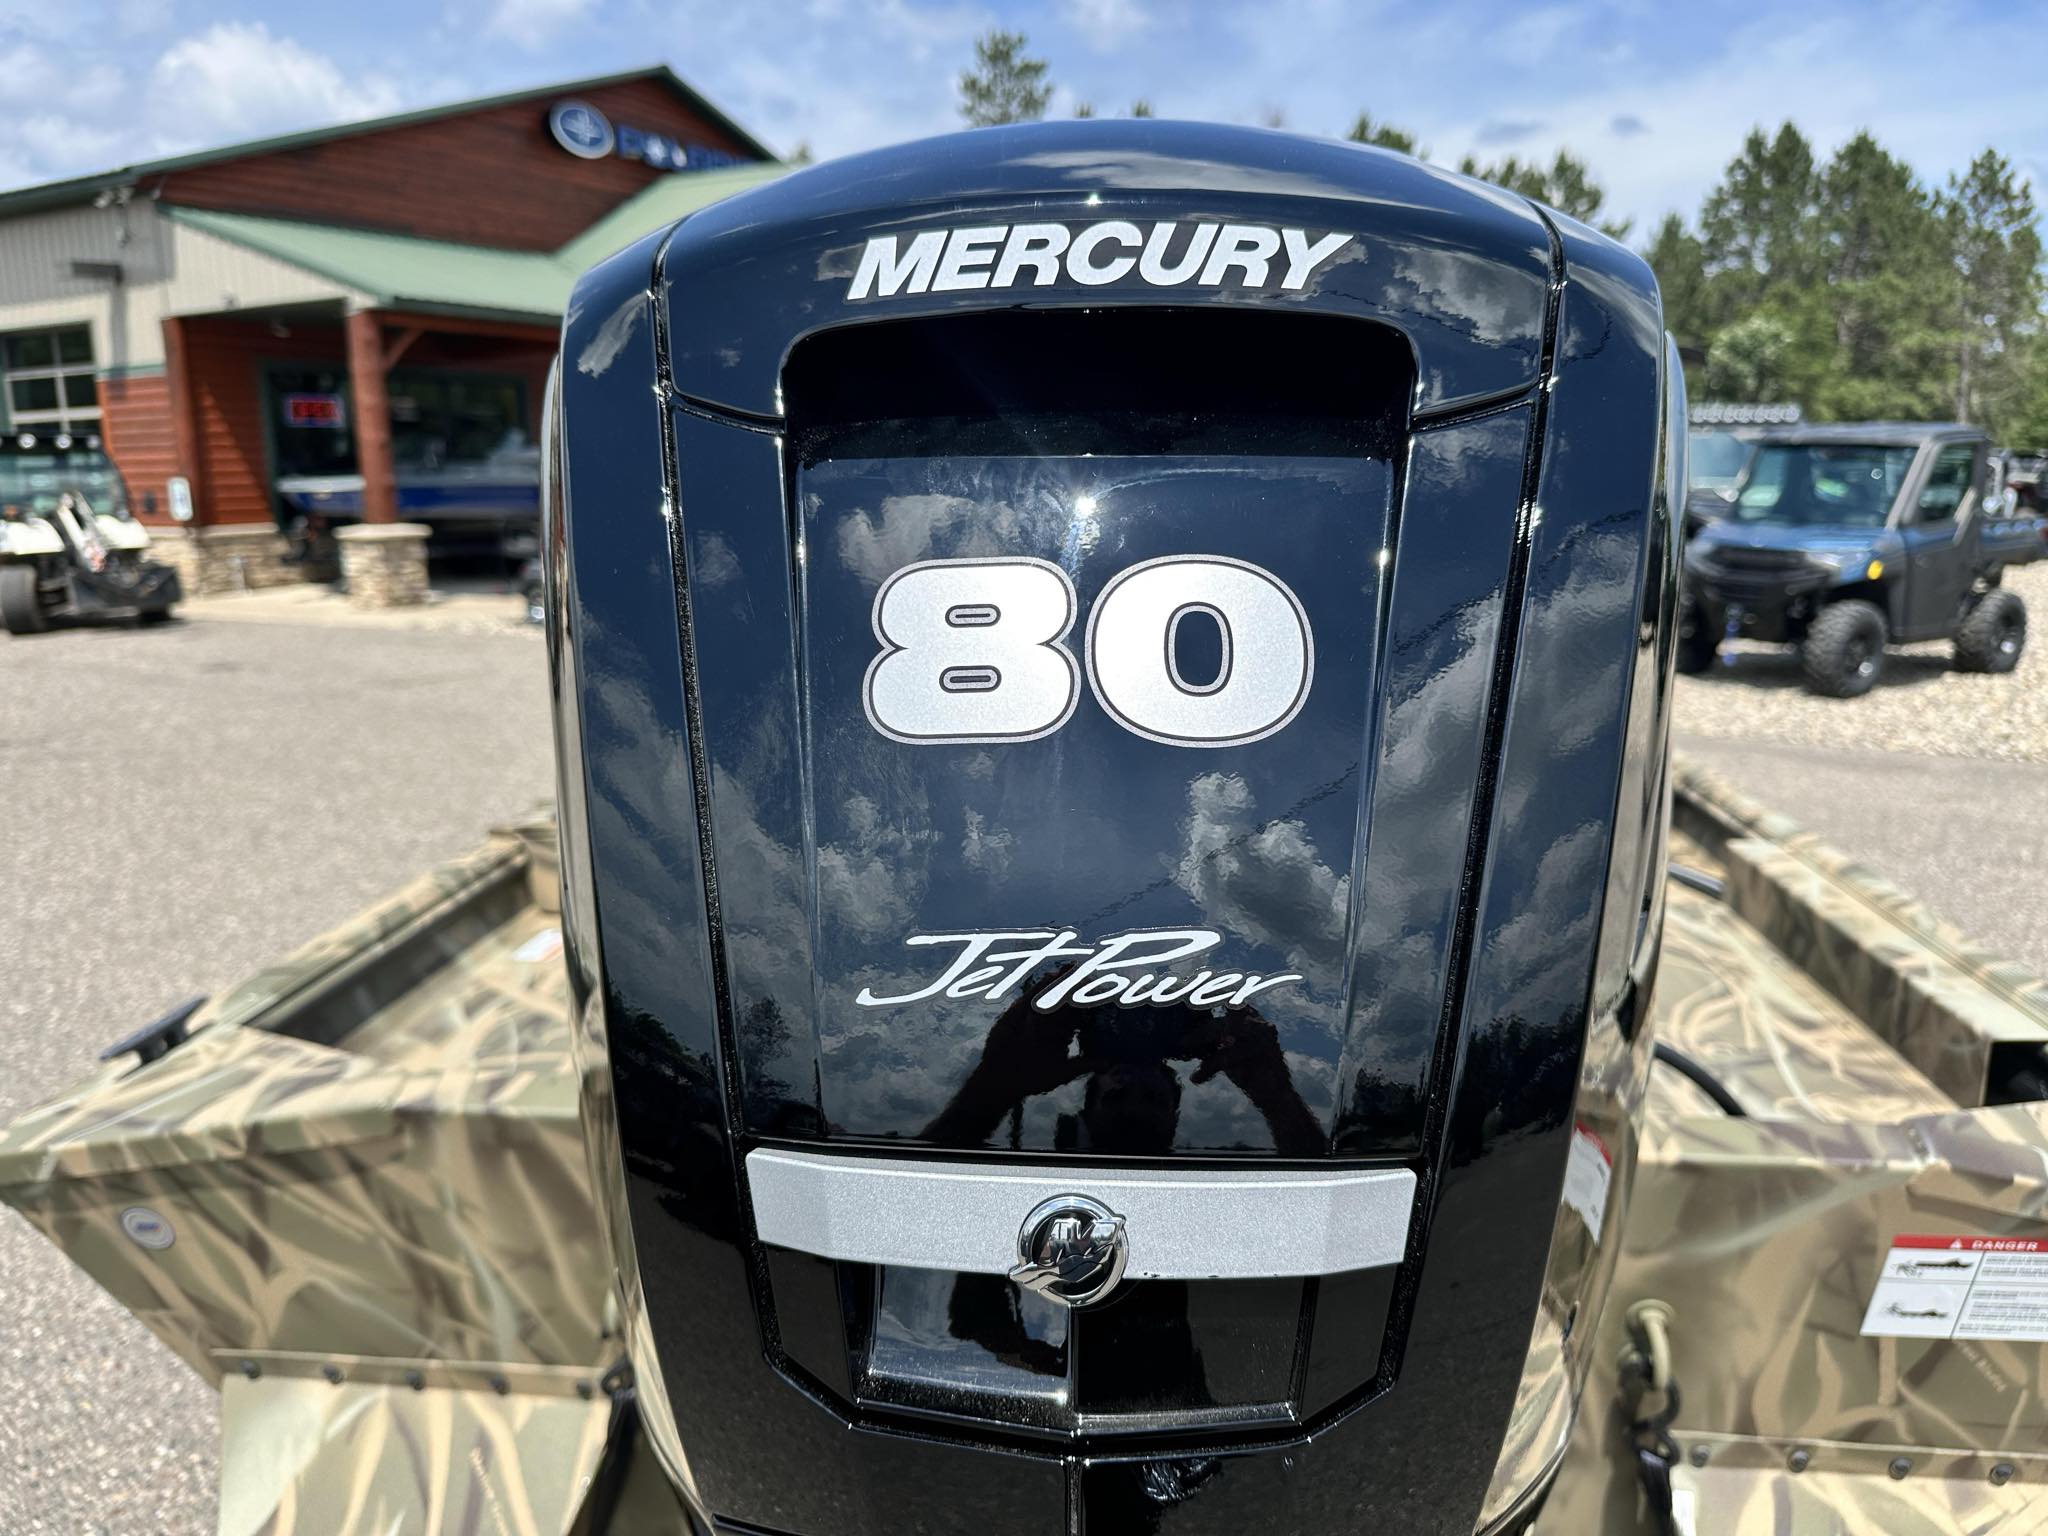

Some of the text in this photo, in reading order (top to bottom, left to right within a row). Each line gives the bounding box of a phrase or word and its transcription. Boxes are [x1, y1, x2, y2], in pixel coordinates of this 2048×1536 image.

[846, 220, 1355, 300] MERCURY
[862, 553, 1315, 748] 80
[1971, 1239, 2038, 1251] DANGER
